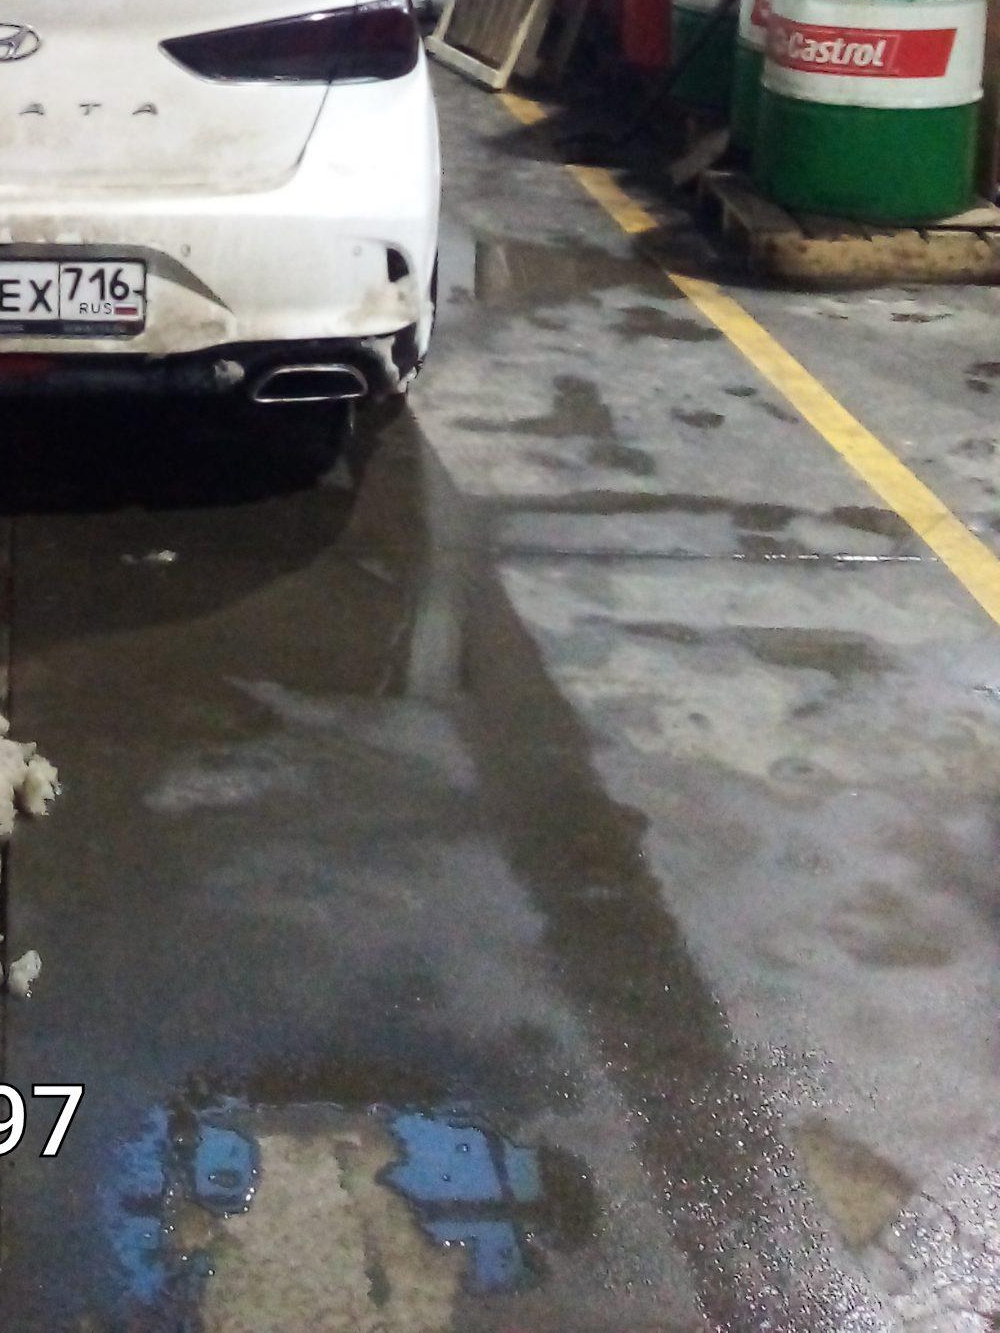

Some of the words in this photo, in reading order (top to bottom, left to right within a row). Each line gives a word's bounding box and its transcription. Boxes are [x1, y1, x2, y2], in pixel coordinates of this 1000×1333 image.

[788, 31, 887, 67] Castrol
[62, 267, 130, 301] 716
[79, 302, 112, 315] RUS
